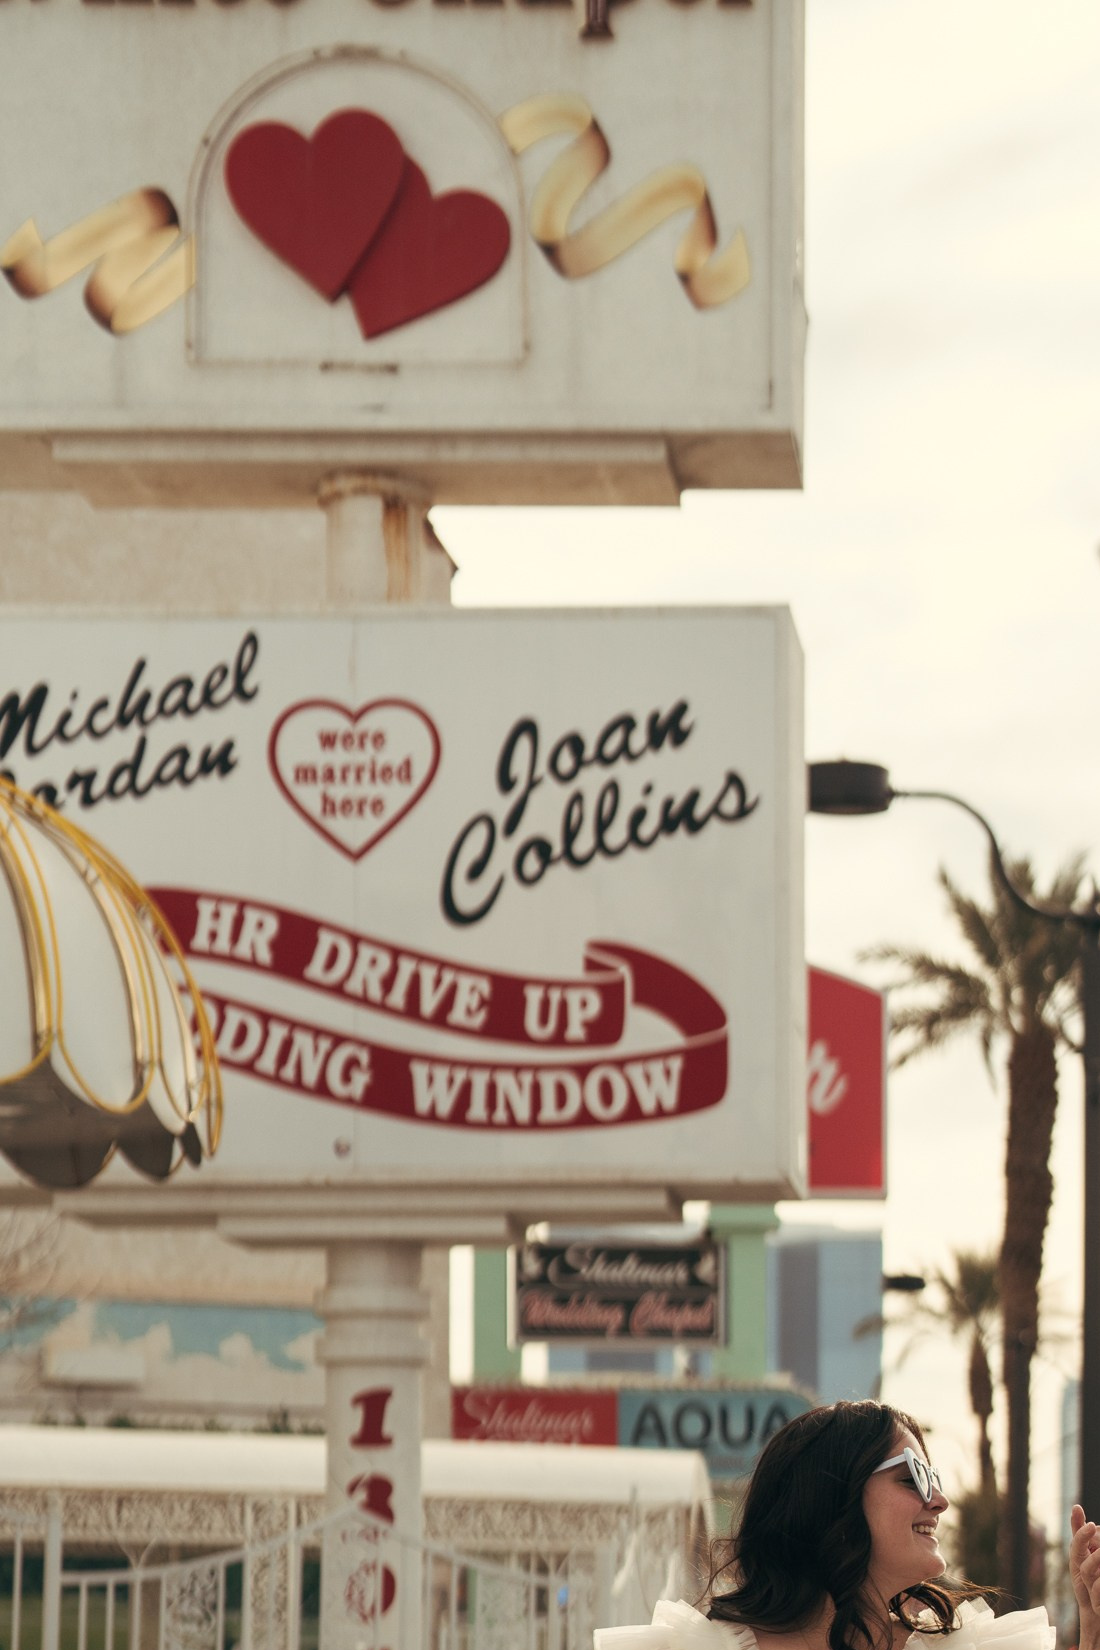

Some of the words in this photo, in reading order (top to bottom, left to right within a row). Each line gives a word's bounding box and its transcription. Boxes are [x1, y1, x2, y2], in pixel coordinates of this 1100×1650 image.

[0, 629, 260, 760] Michael
[0, 733, 238, 811] ordan
[294, 756, 412, 785] married
[318, 730, 386, 752] were
[496, 698, 695, 838] Joan
[321, 791, 385, 817] here
[440, 769, 760, 928] Collins
[190, 898, 280, 966] HR
[303, 928, 491, 1030] DRIVE
[523, 983, 602, 1042] UP
[409, 1054, 683, 1125] WINDOW
